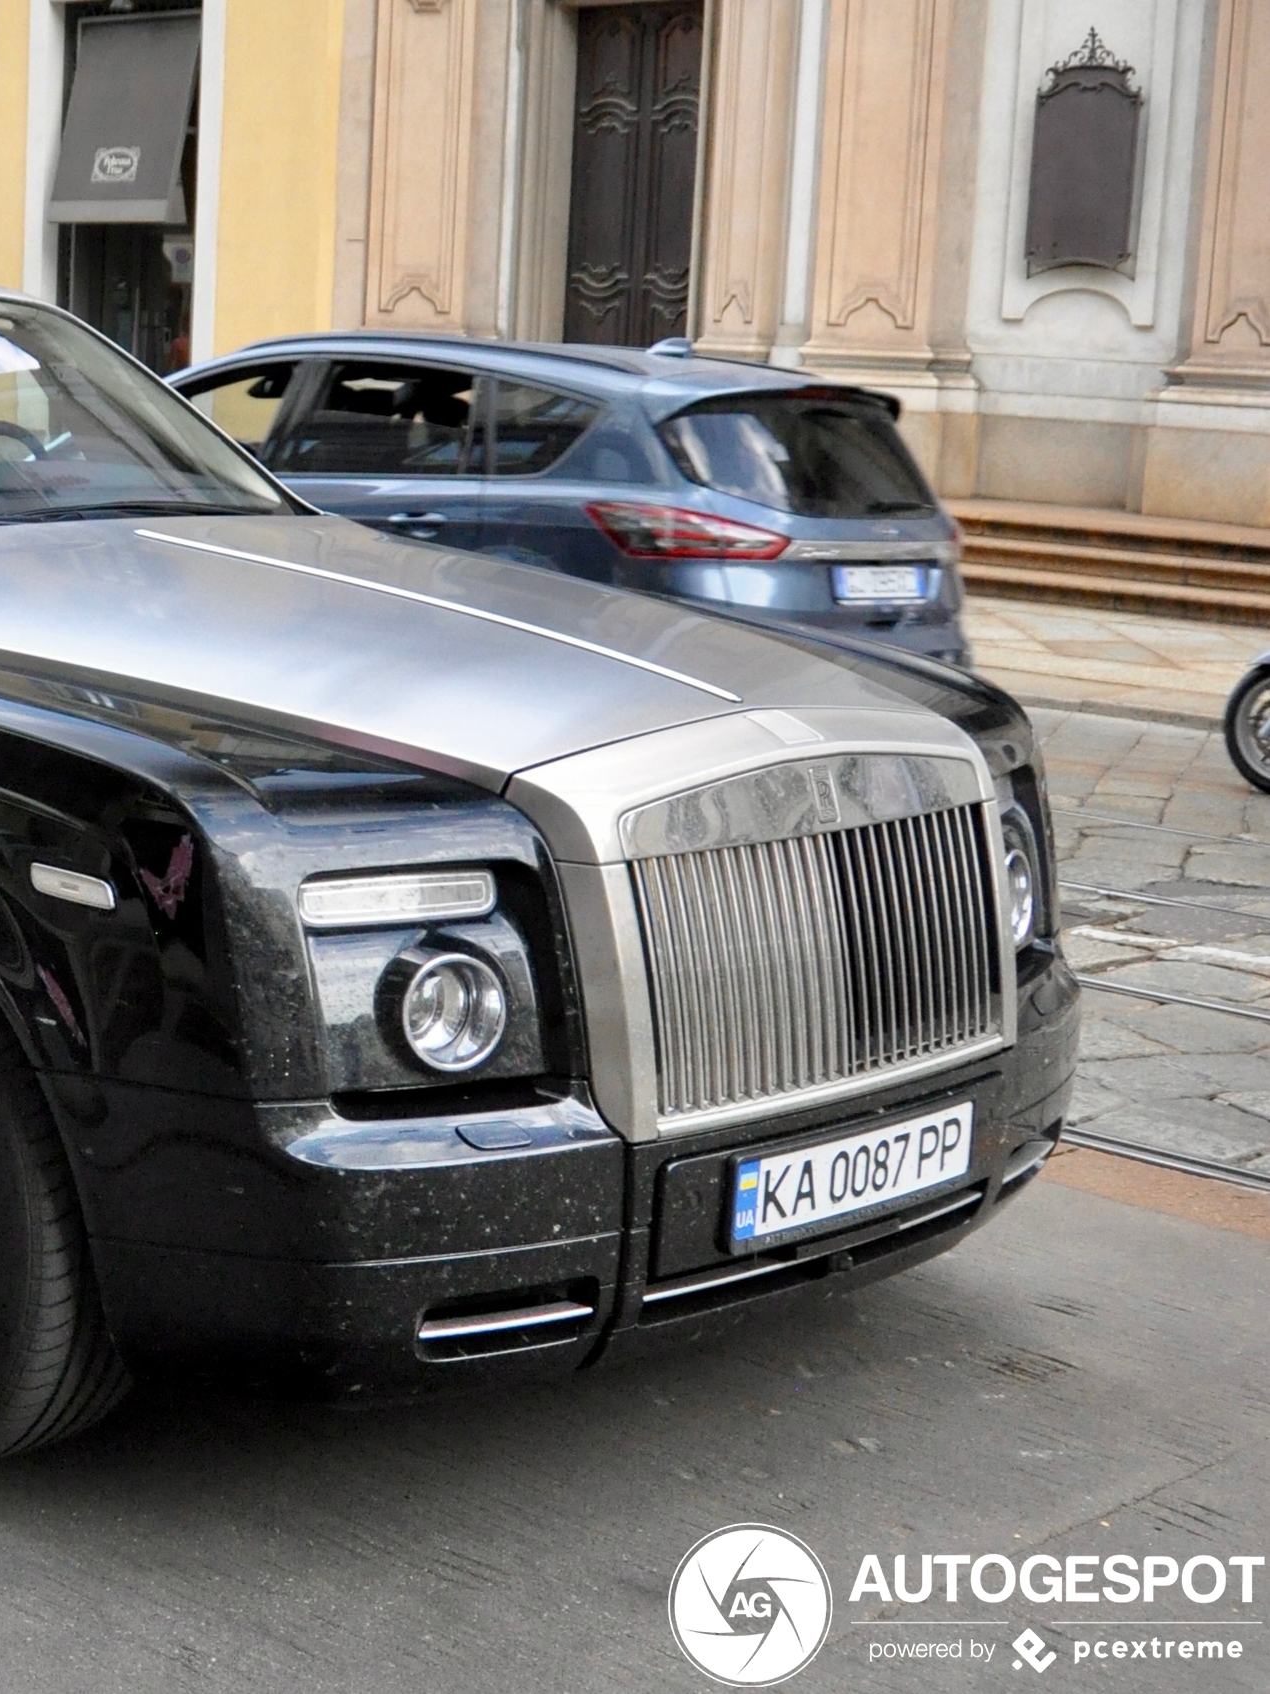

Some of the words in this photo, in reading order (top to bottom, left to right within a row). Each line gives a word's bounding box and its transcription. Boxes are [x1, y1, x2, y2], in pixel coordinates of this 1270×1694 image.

[761, 1159, 816, 1223] KA
[829, 1131, 911, 1204] 0087
[917, 1117, 962, 1180] PP
[735, 1210, 754, 1229] UA
